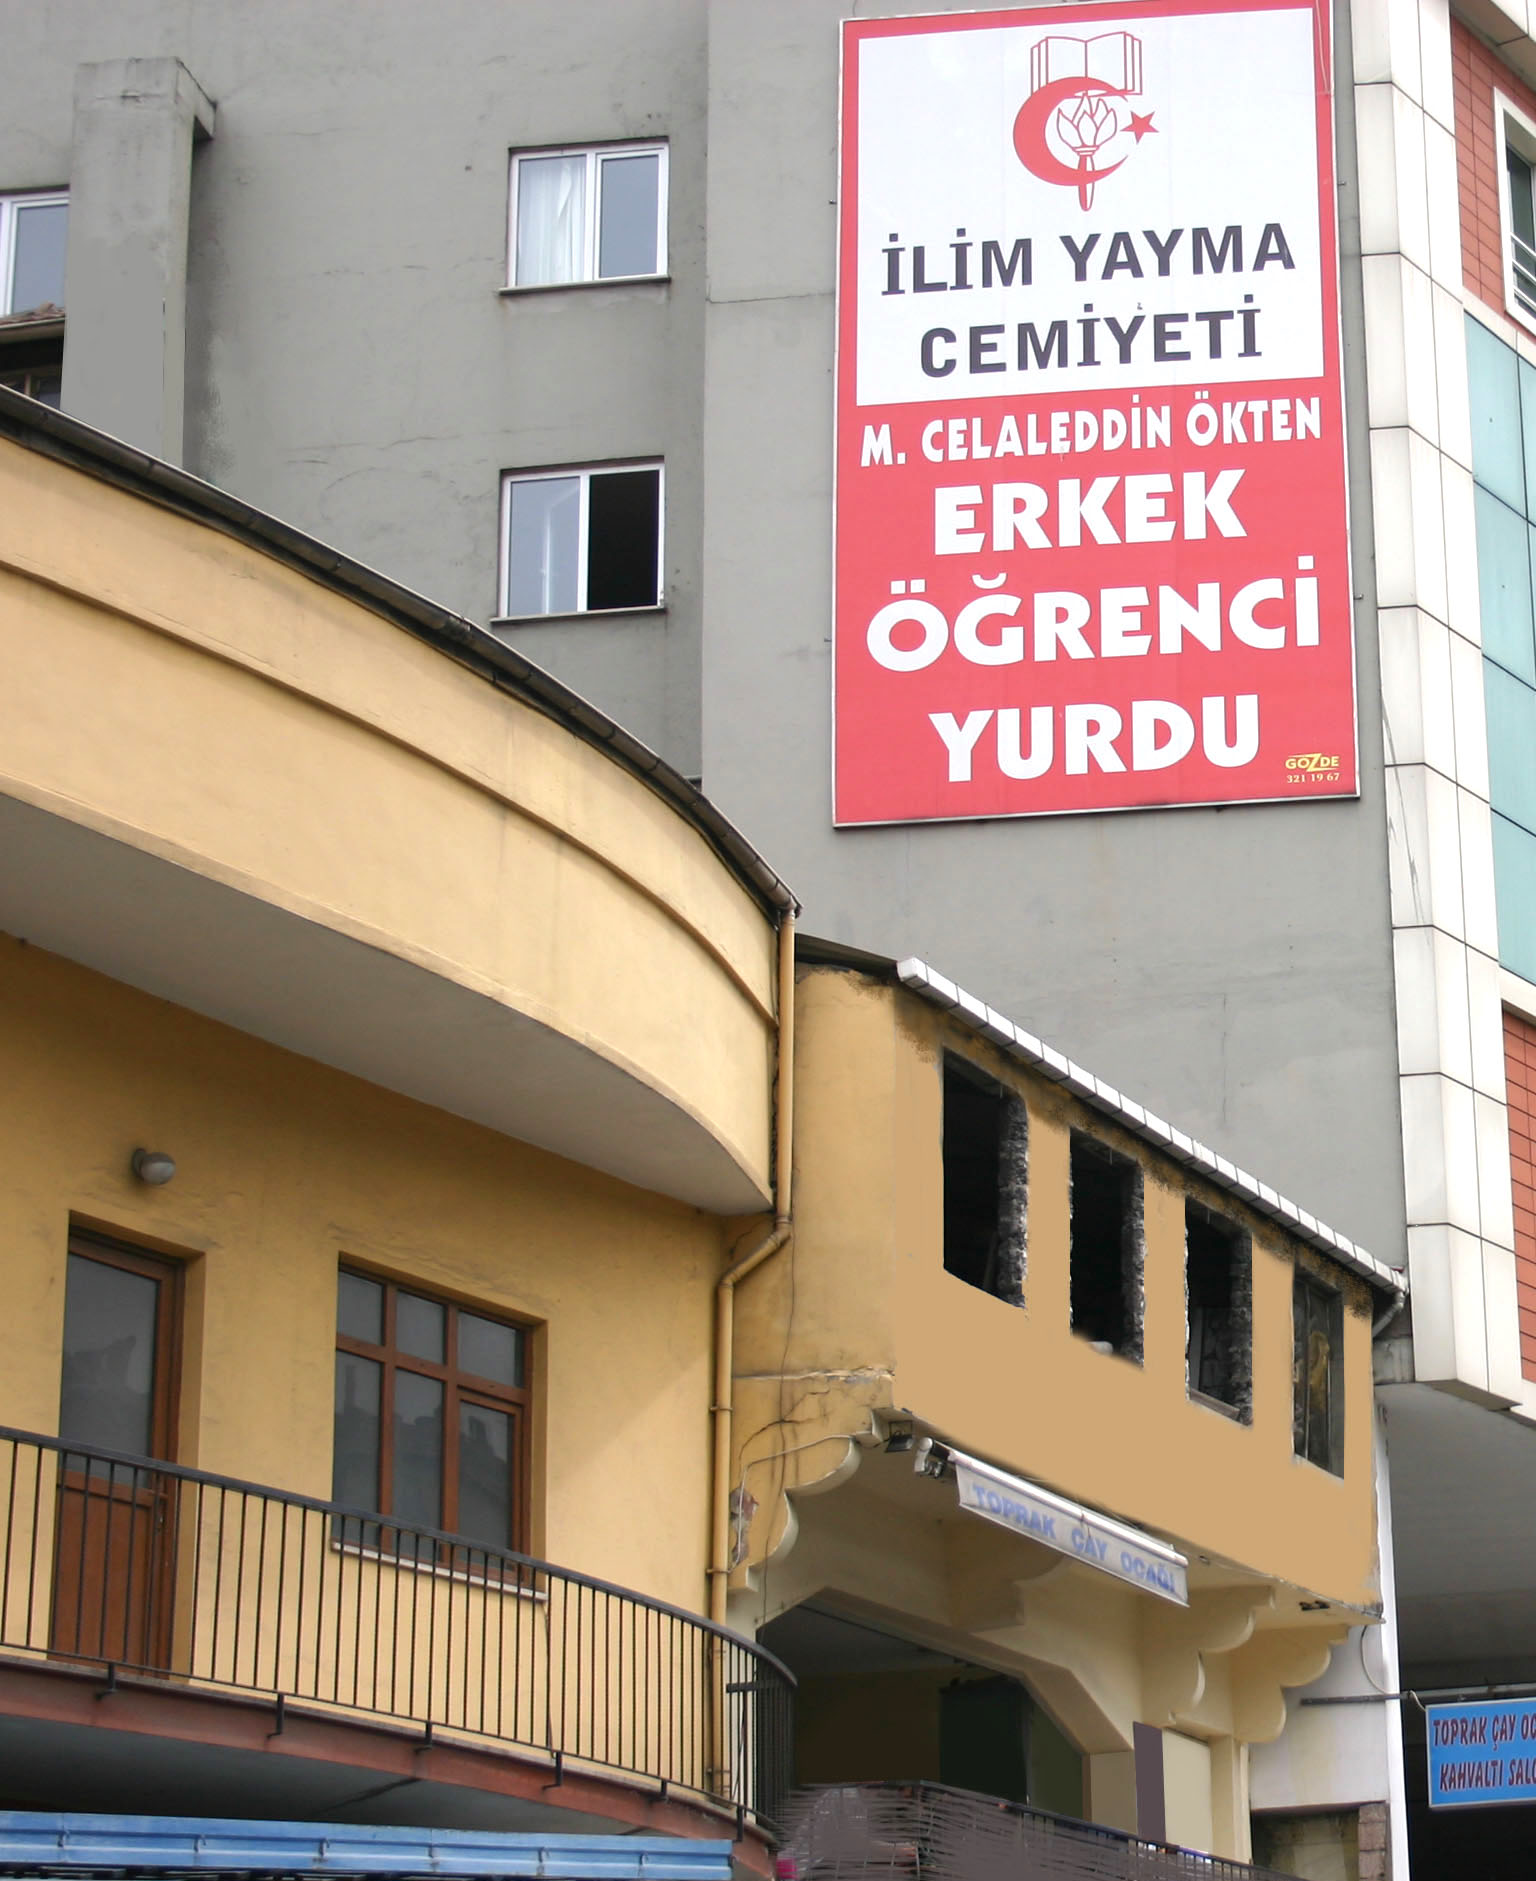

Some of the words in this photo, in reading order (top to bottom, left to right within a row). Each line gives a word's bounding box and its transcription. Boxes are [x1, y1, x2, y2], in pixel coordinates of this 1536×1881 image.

[881, 228, 1033, 295] İLİM
[1060, 223, 1295, 281] YAYMA
[921, 294, 1262, 378] CEMİYETİ
[860, 424, 906, 467] M.
[921, 394, 1171, 462] CELALEDDİN
[1186, 391, 1321, 447] ÖKTEN
[934, 469, 1248, 555] ERKEK
[866, 555, 1320, 672] ÖĞRENCİ
[928, 694, 1260, 782] YURDU
[1286, 774, 1306, 784] 321
[1311, 773, 1324, 782] 19
[1326, 772, 1340, 781] 67
[972, 1484, 1057, 1539] TOPRAK
[1433, 1716, 1488, 1747] TOPRAK
[1492, 1714, 1516, 1751] ÇAY
[1439, 1759, 1504, 1792] KAHVALTI
